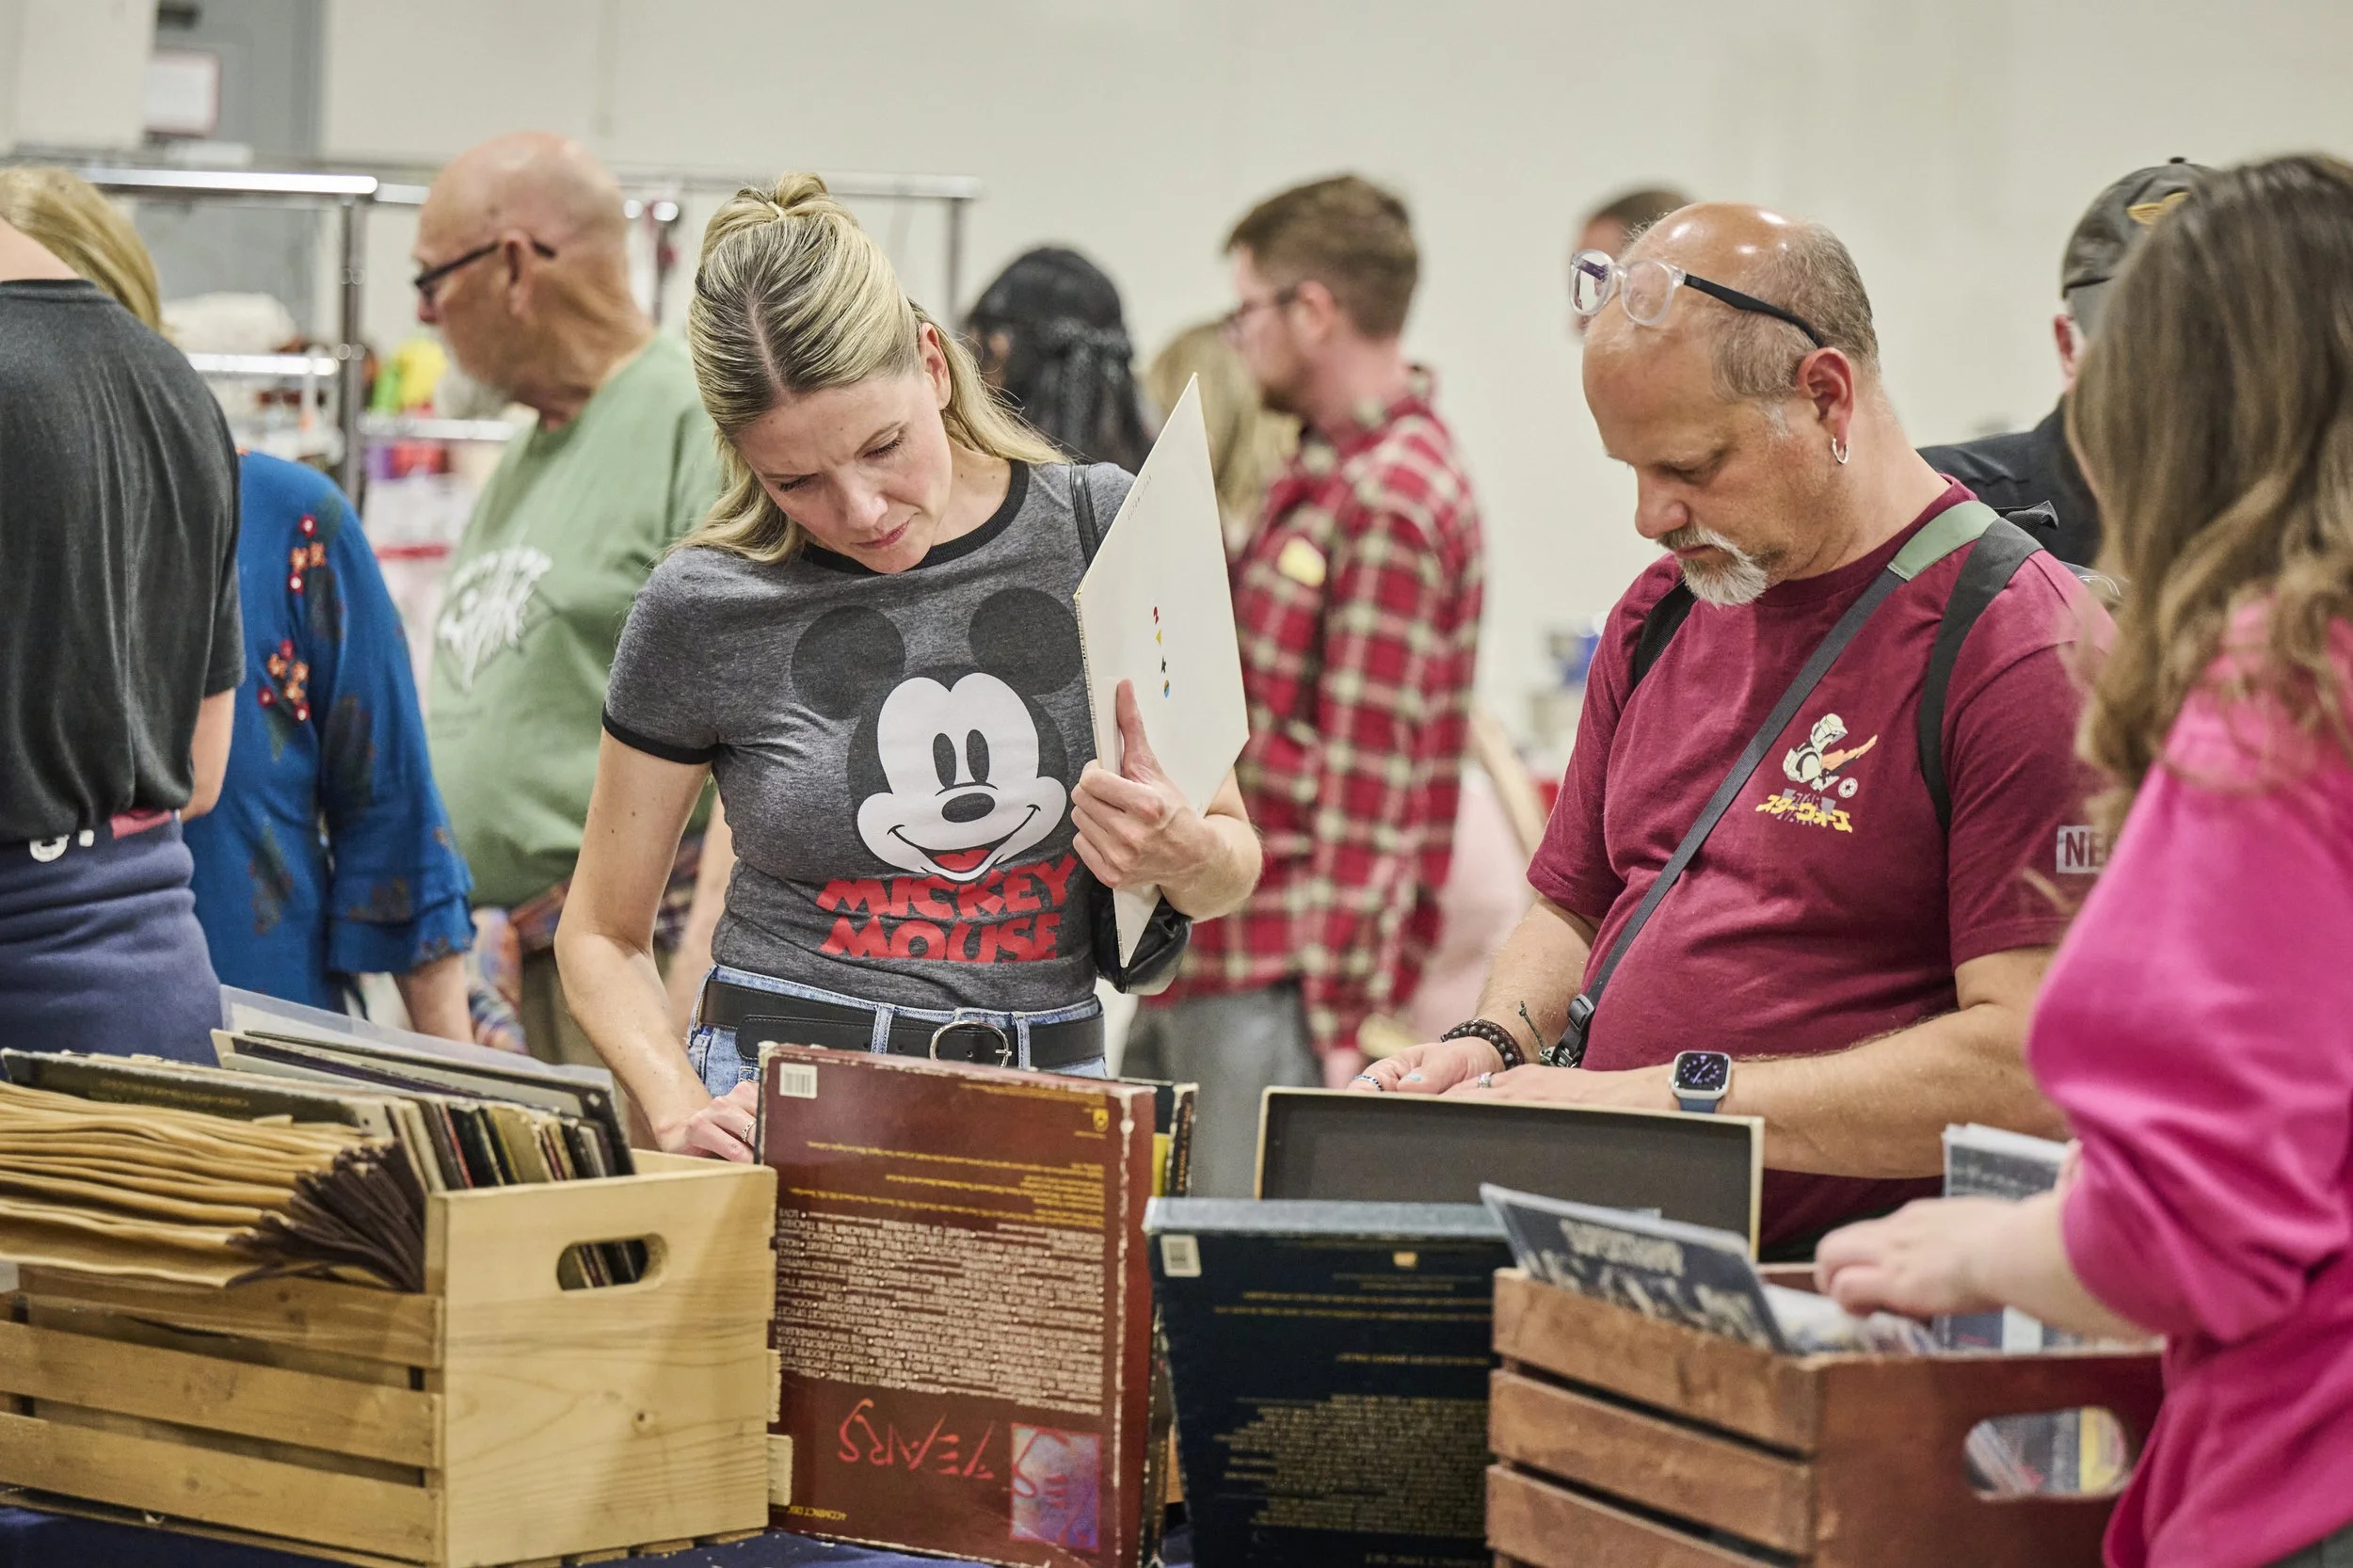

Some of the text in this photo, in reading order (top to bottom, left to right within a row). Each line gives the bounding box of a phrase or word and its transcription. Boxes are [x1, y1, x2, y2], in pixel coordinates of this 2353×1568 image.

[2065, 831, 2110, 868] NE
[815, 853, 1078, 920] MICKEY
[819, 913, 1062, 964] MOUSE
